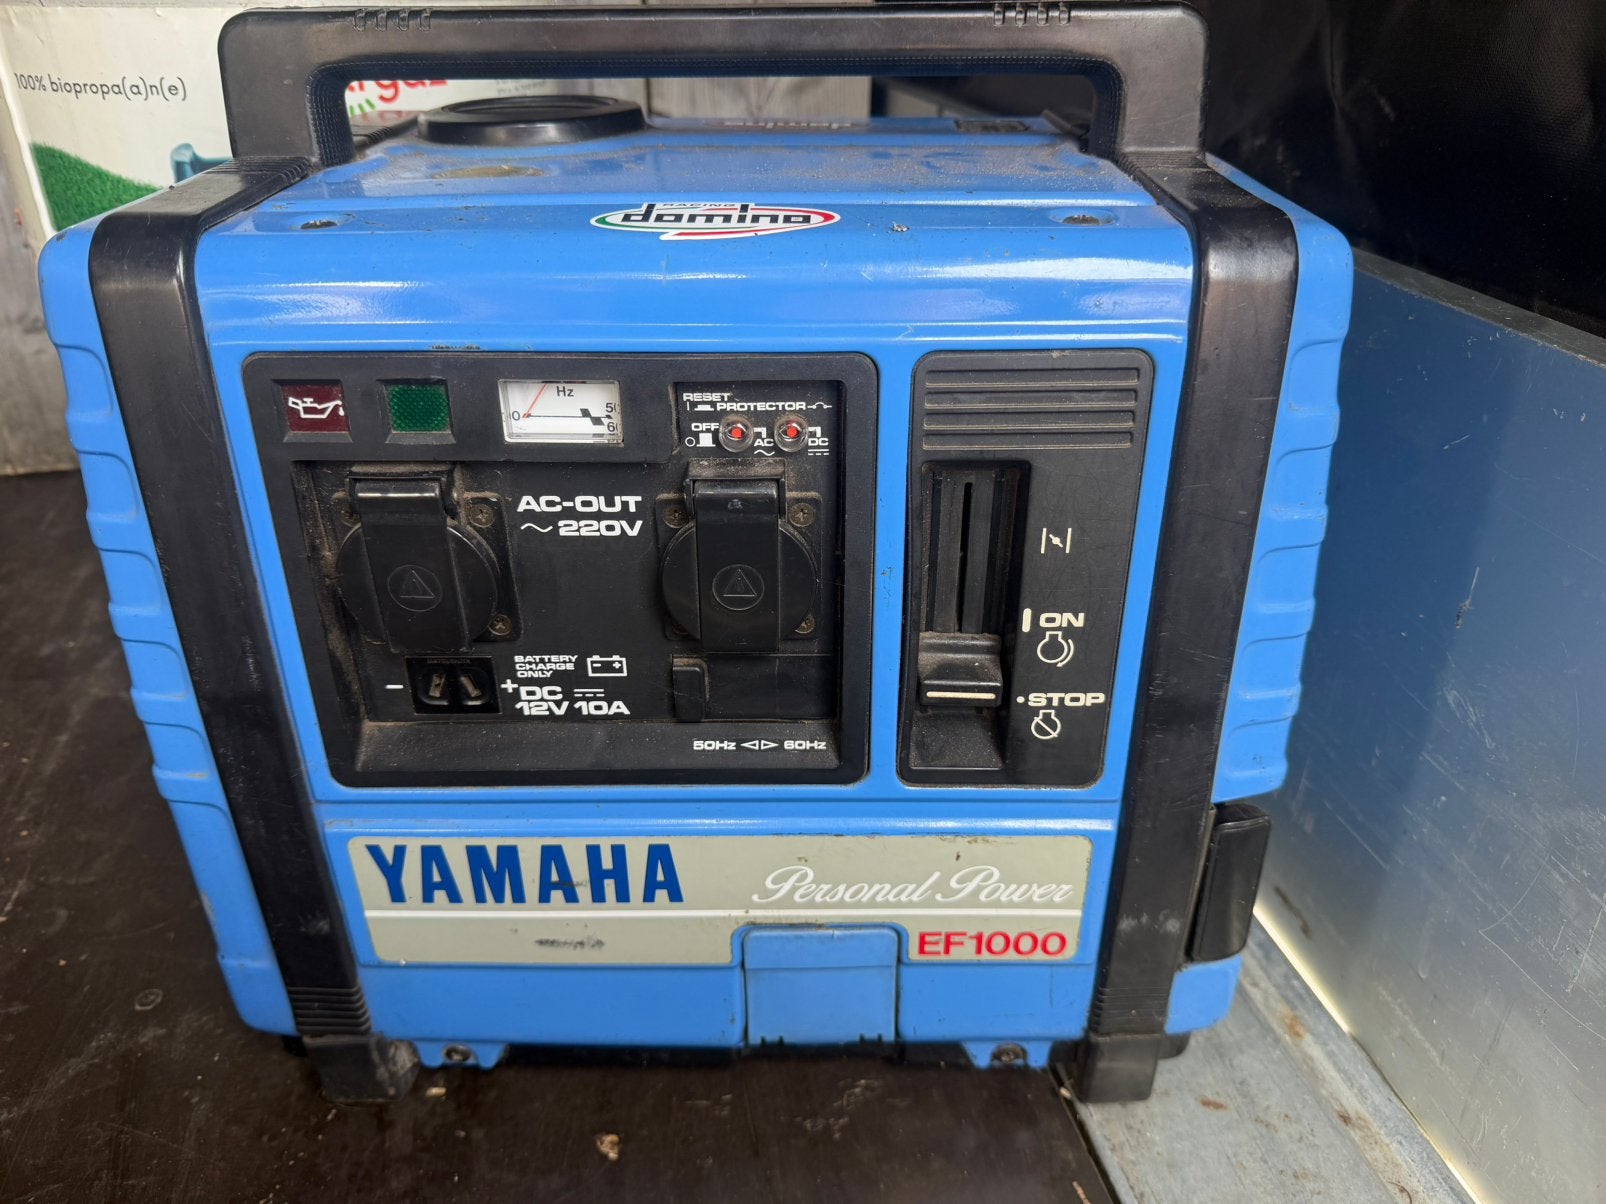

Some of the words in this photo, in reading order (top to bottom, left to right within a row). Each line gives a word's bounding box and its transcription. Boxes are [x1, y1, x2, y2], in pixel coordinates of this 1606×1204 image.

[14, 73, 47, 92] 100%
[48, 73, 187, 102] biopropa(a)n(e)
[621, 203, 812, 224] domino
[556, 385, 575, 398] Hz
[682, 392, 731, 402] RESET
[716, 401, 807, 412] PROTECTOR
[511, 410, 521, 422] 0
[691, 422, 720, 432] OFF
[753, 438, 775, 447] AC
[807, 437, 829, 447] DC
[516, 495, 642, 513] AC-OUT
[557, 519, 644, 537] 220V
[1039, 612, 1085, 628] ON
[514, 654, 578, 663] BATTERY
[515, 662, 575, 671] CHARGE
[516, 670, 553, 678] ONLY
[519, 685, 563, 701] DC
[1027, 692, 1106, 707] STOP
[515, 700, 570, 716] 12V
[573, 700, 631, 716] 10A
[692, 740, 737, 750] 50Hz
[783, 740, 827, 750] 60Hz
[364, 843, 685, 904] YAMAHA
[752, 864, 942, 905] Personal
[935, 864, 1074, 904] Power
[917, 931, 1068, 956] EF1000
